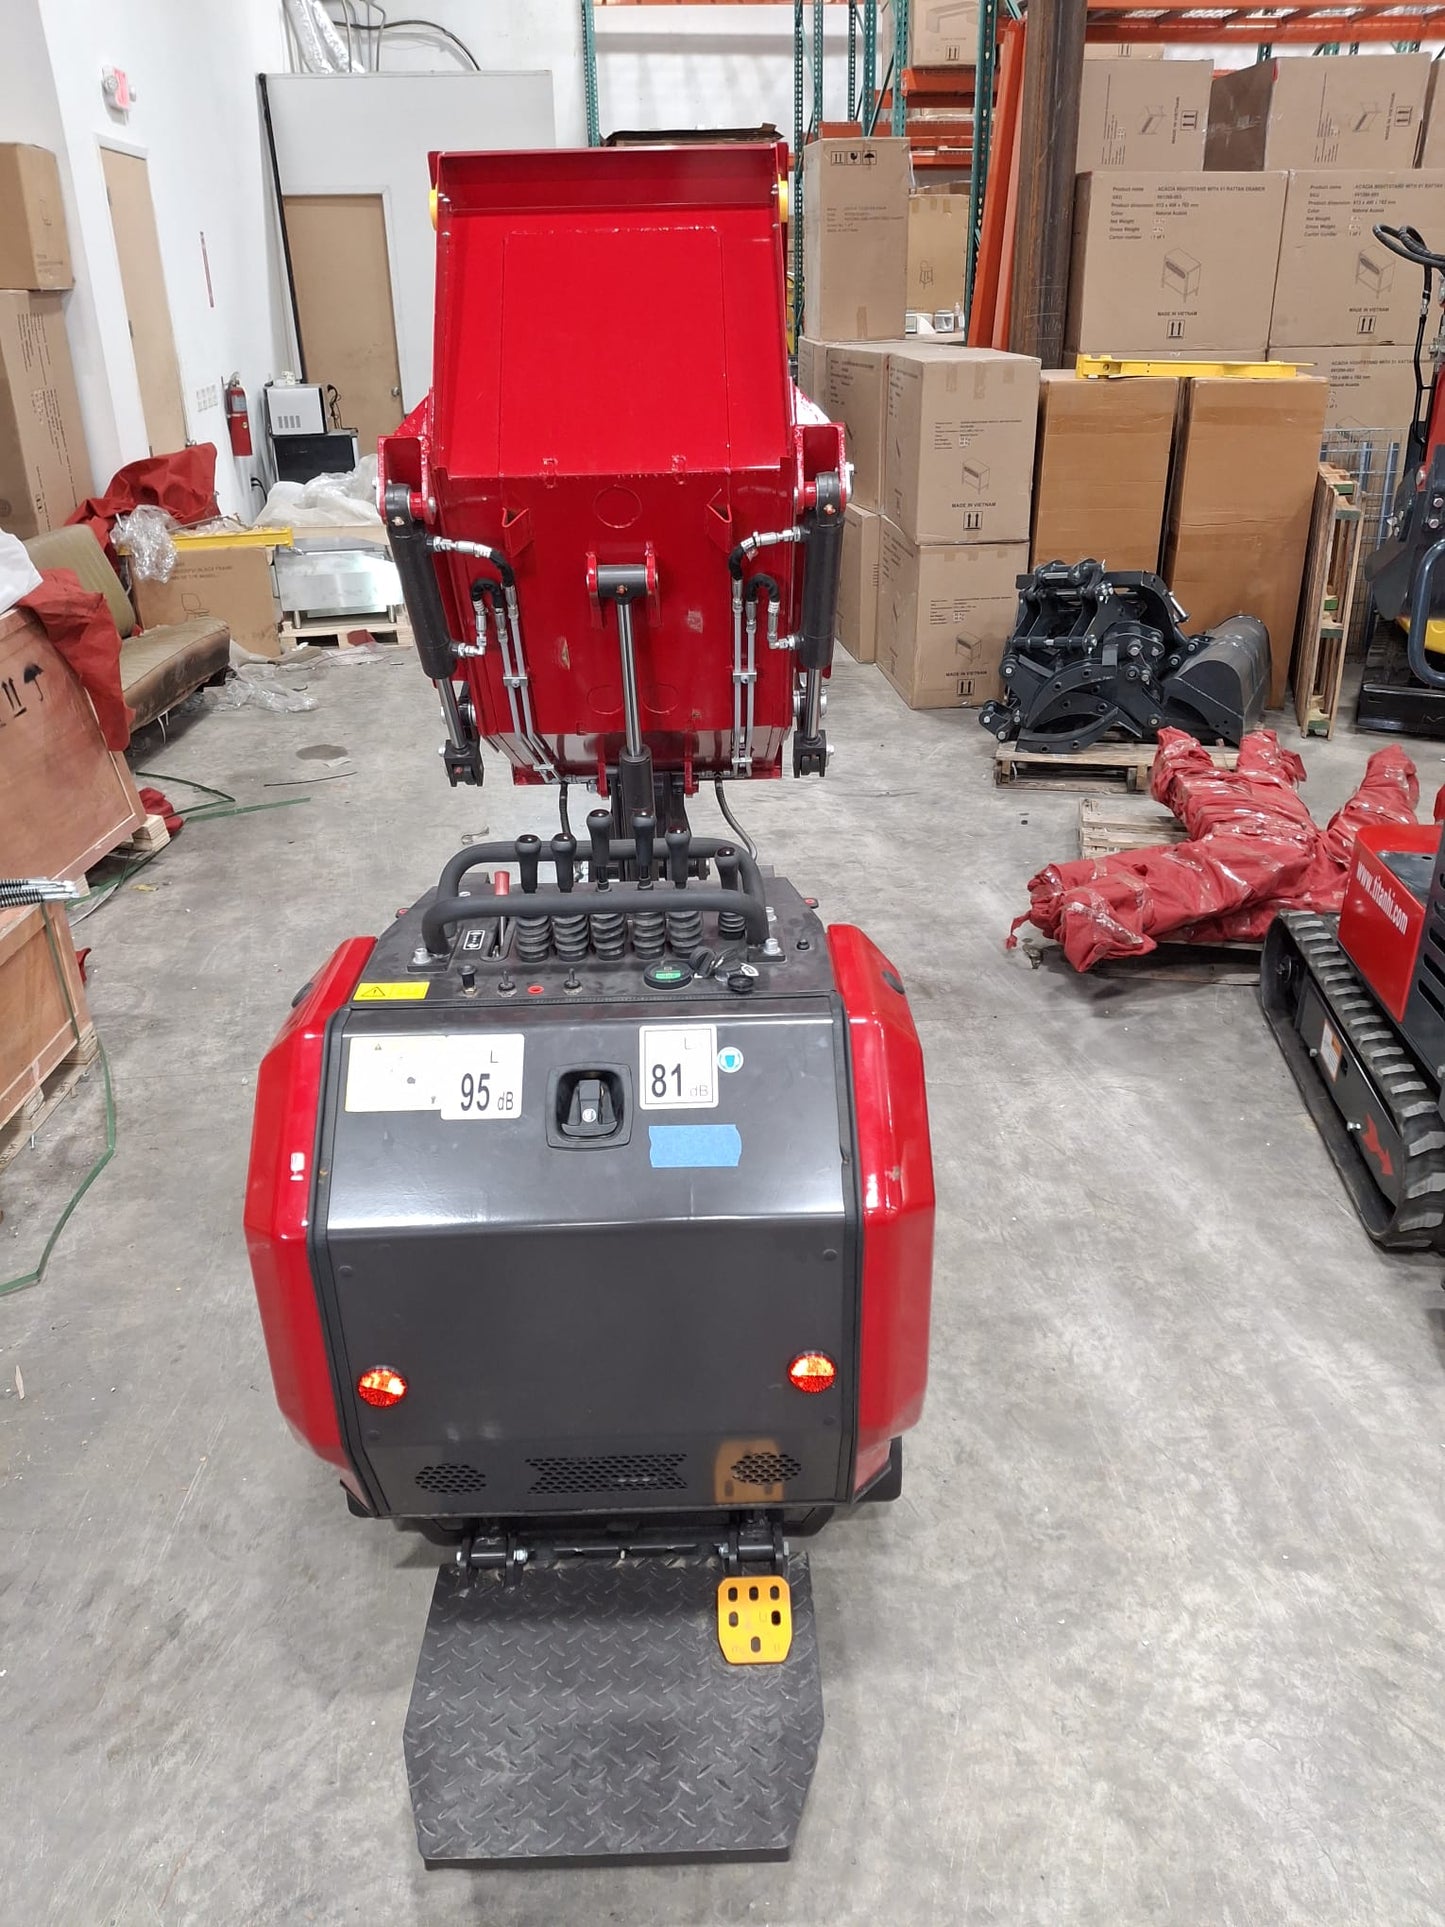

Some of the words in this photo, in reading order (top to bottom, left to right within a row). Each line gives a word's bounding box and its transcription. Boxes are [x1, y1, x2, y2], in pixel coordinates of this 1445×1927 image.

[1356, 861, 1408, 935] www.titanhi.com
[460, 1073, 491, 1112] 95
[498, 1091, 514, 1111] dB
[651, 1063, 682, 1099] 81
[690, 1085, 708, 1097] dB
